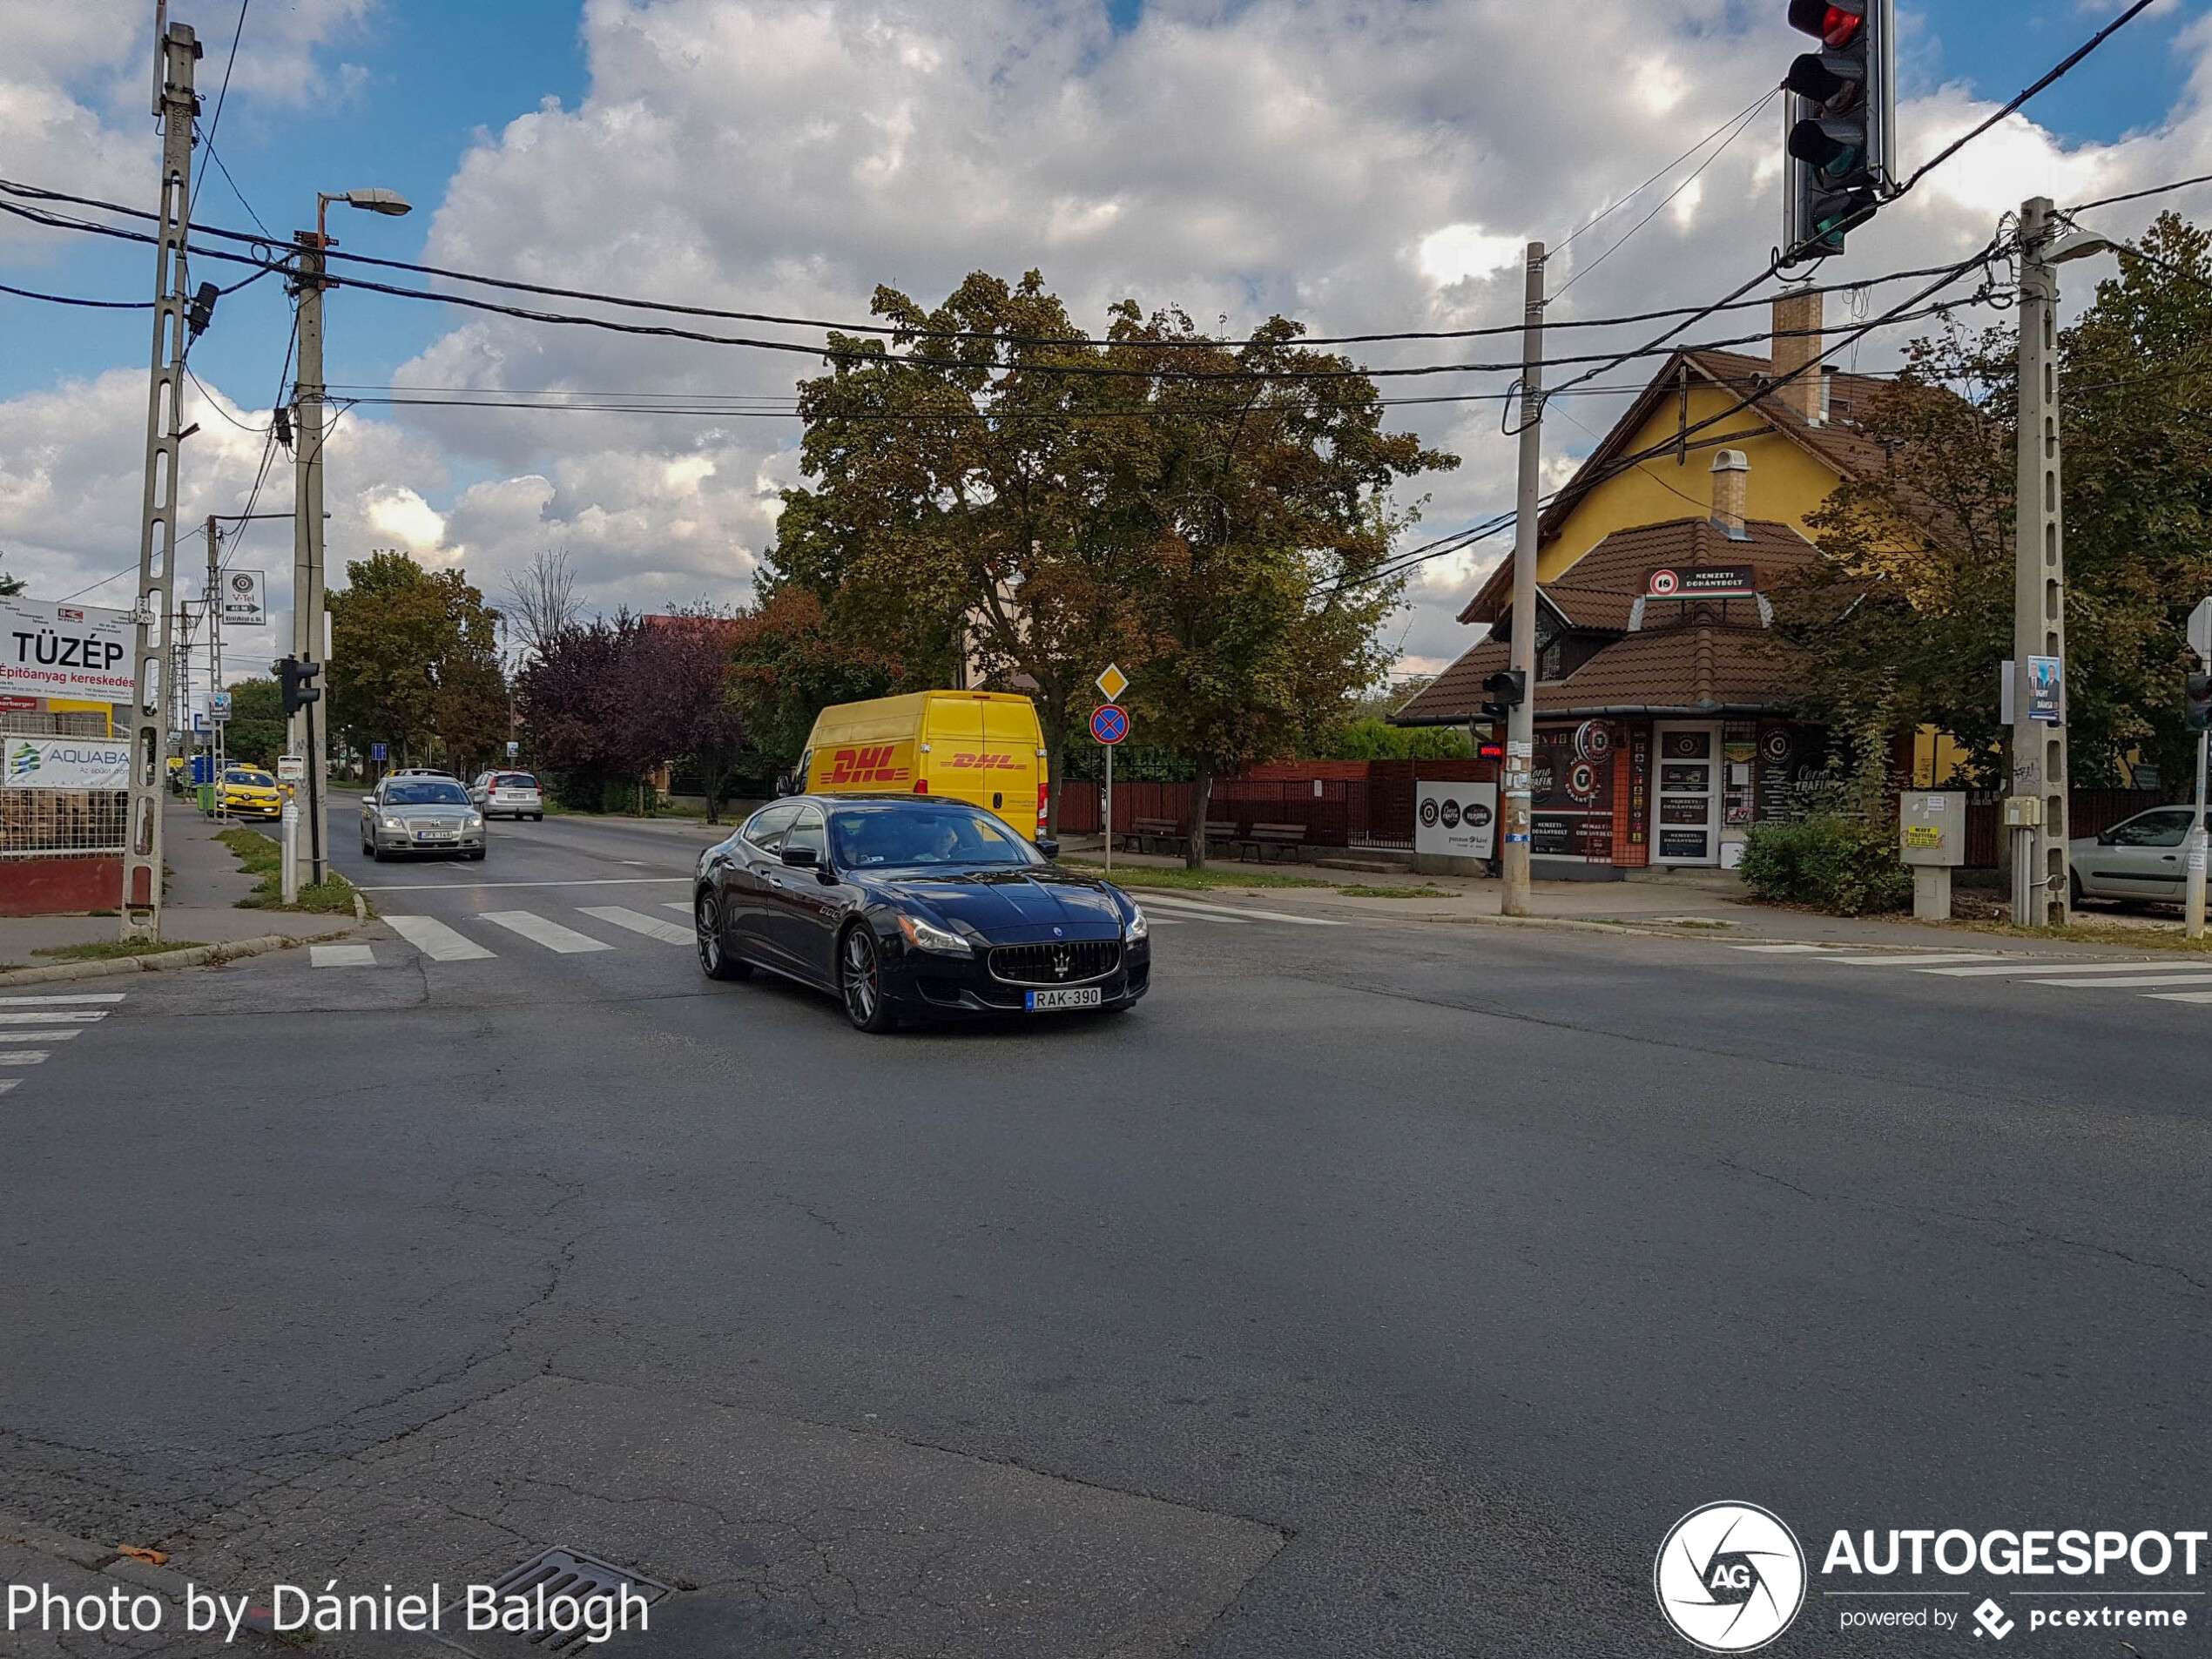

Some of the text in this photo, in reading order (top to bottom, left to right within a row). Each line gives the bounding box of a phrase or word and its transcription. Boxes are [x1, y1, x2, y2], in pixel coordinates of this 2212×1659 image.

[1658, 579, 1670, 588] 18
[12, 629, 124, 671] TÜZÉP
[0, 664, 135, 688] Építőanyag kereskedés
[832, 745, 895, 784] DHL
[953, 752, 1015, 769] DHL
[1036, 989, 1098, 1007] RAK-390
